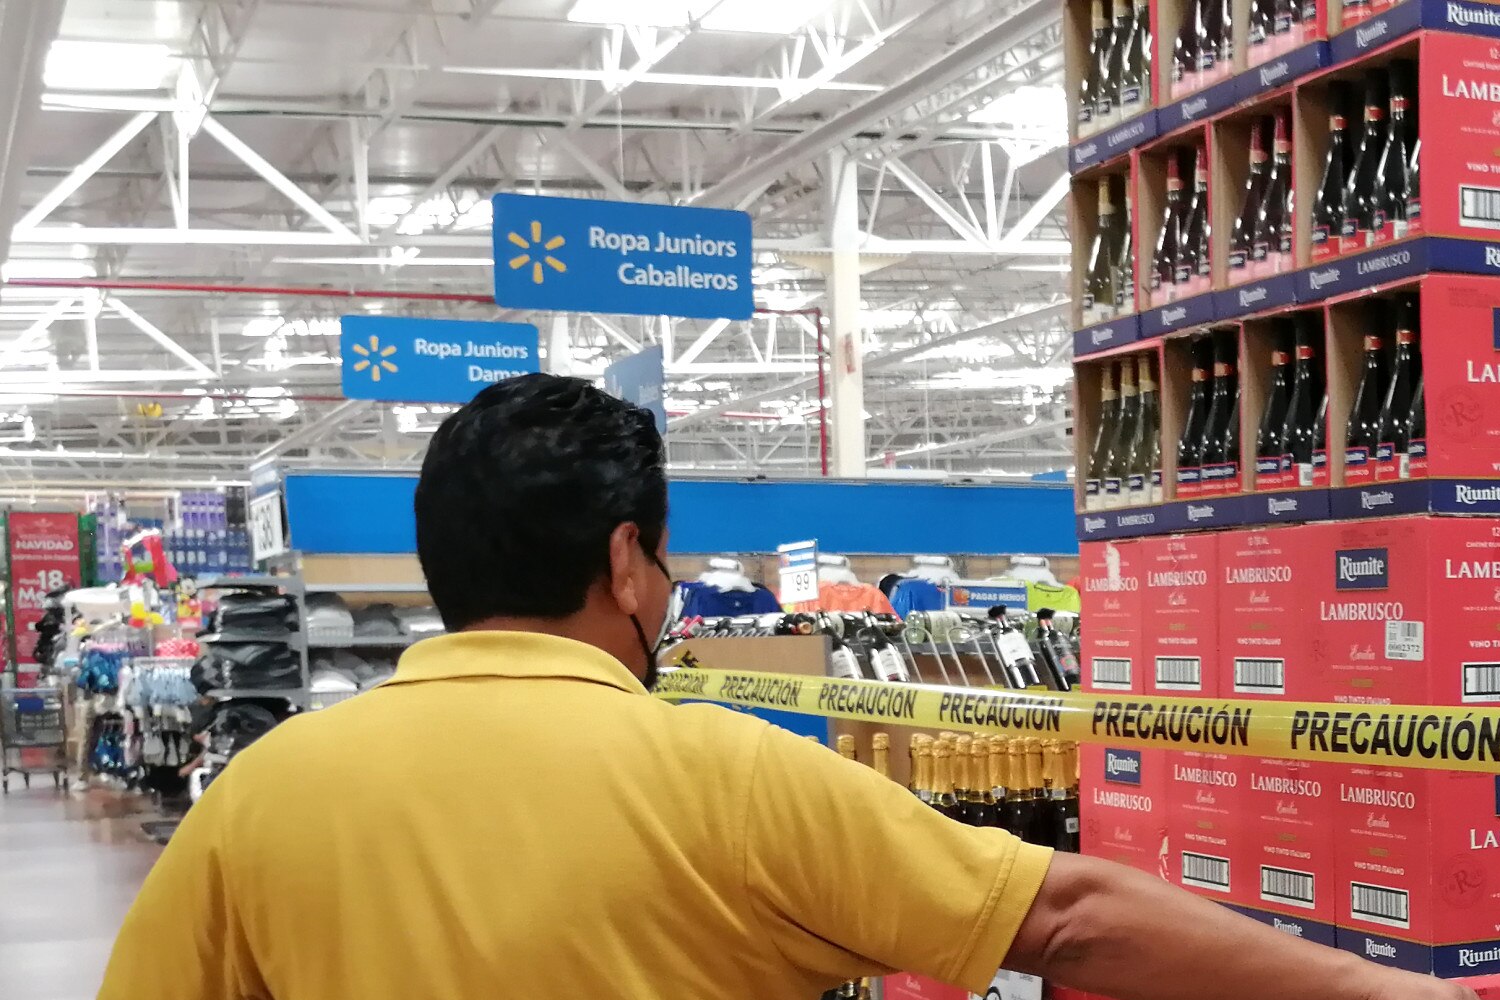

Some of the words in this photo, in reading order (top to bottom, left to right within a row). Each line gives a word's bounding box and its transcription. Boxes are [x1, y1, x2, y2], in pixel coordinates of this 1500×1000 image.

[1466, 162, 1488, 173] VINO
[590, 226, 650, 255] Ropa
[655, 232, 737, 257] Juniors
[1357, 251, 1410, 275] LAMBRUSCO
[618, 263, 738, 291] Caballeros
[415, 338, 462, 359] Ropa
[463, 342, 528, 359] Juniors
[16, 540, 73, 550] NAVIDAD
[37, 570, 63, 588] 18
[1148, 570, 1207, 588] LAMBRUSCO
[1226, 565, 1292, 584] LAMBRUSCO
[1339, 555, 1384, 581] Riunite
[1320, 601, 1403, 622] LAMBRUSCO
[1469, 639, 1491, 649] VINO
[720, 675, 803, 707] PRECAUCIÓN
[818, 682, 917, 719] PRECAUCIÓN
[938, 691, 1065, 732] PRECAUCIÓN
[1091, 701, 1252, 747] PRECAUCIÓN
[1107, 752, 1139, 776] Riunite
[1174, 764, 1237, 788] LAMBRUSCO
[1251, 773, 1322, 798] LAMBRUSCO
[1340, 783, 1416, 809] LAMBRUSCO
[1093, 787, 1152, 812] LAMBRUSCO
[1365, 938, 1397, 959] Riunite
